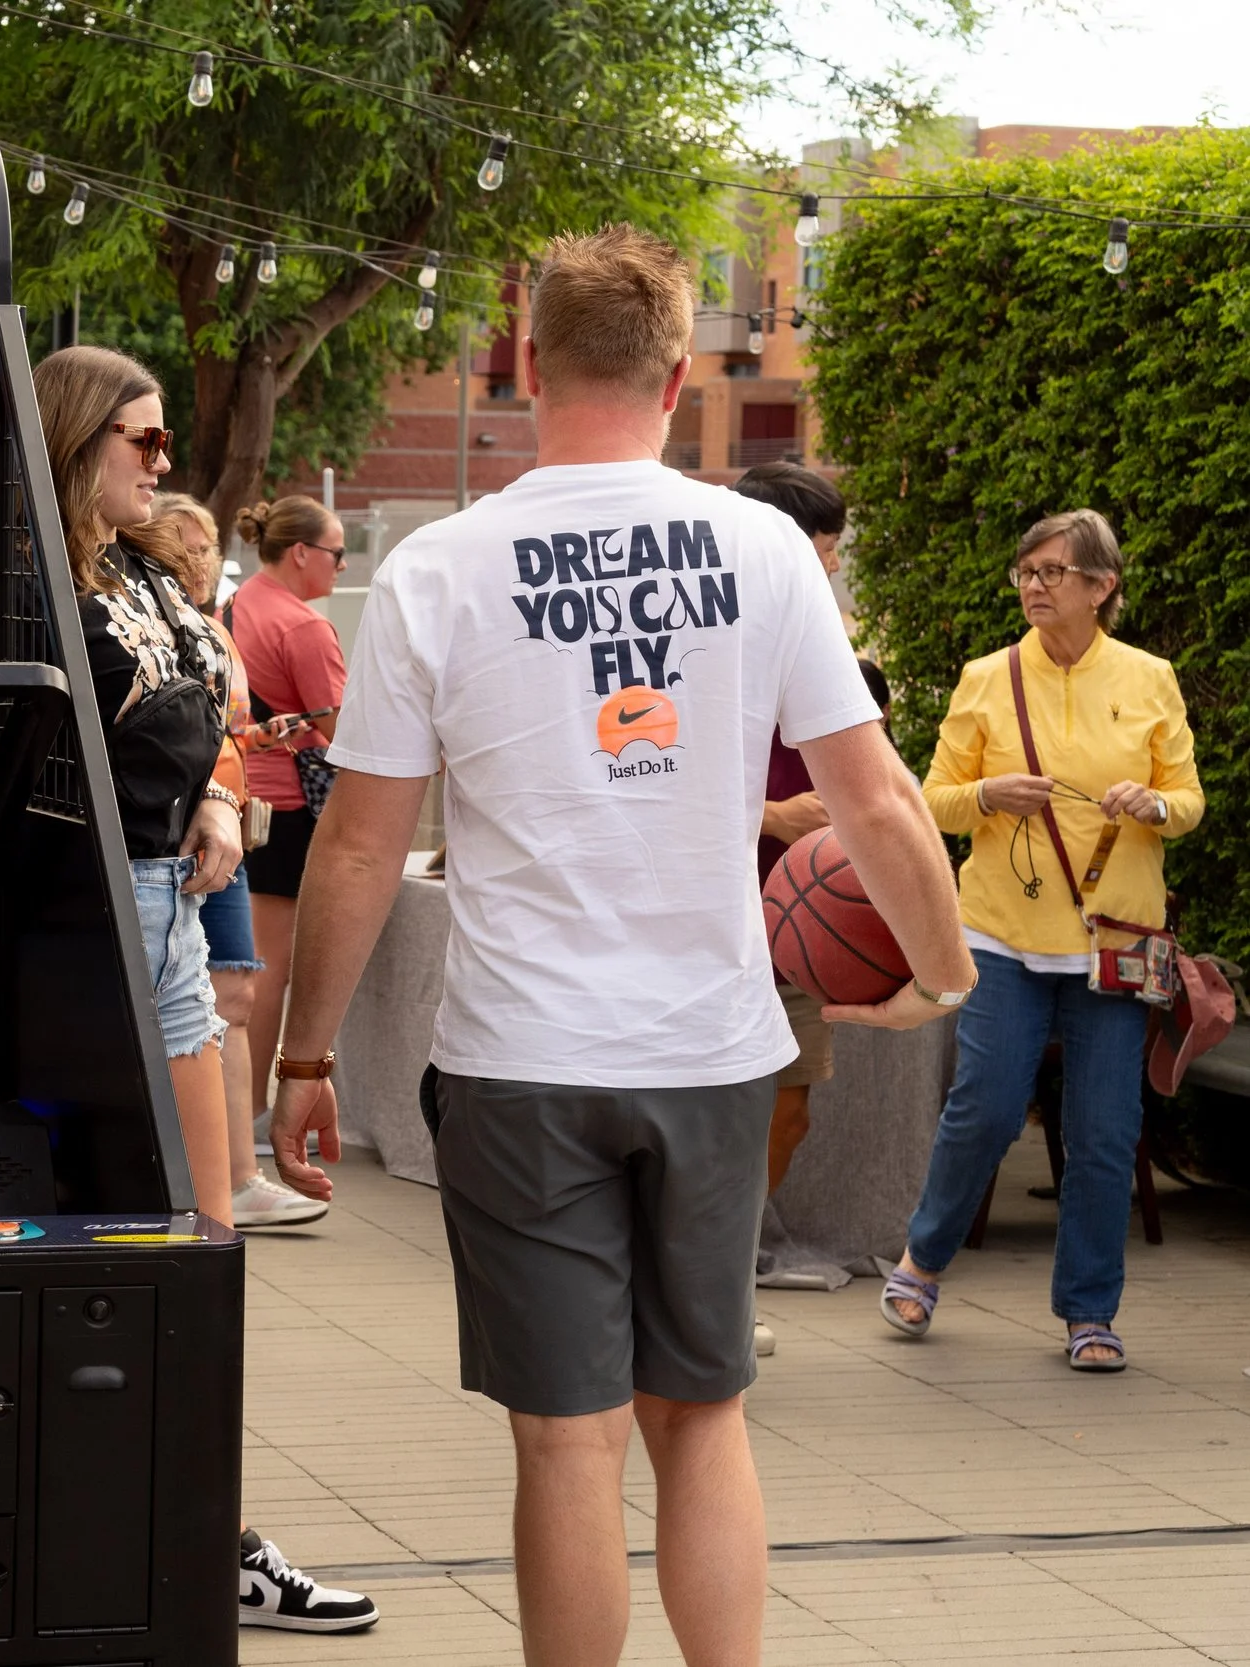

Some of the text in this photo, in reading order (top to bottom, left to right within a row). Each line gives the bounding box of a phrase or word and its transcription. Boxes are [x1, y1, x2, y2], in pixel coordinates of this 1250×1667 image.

[512, 519, 722, 588] DREAM
[510, 585, 622, 643] YOU
[629, 572, 741, 633] CAN
[608, 758, 679, 782] Just Do It.
